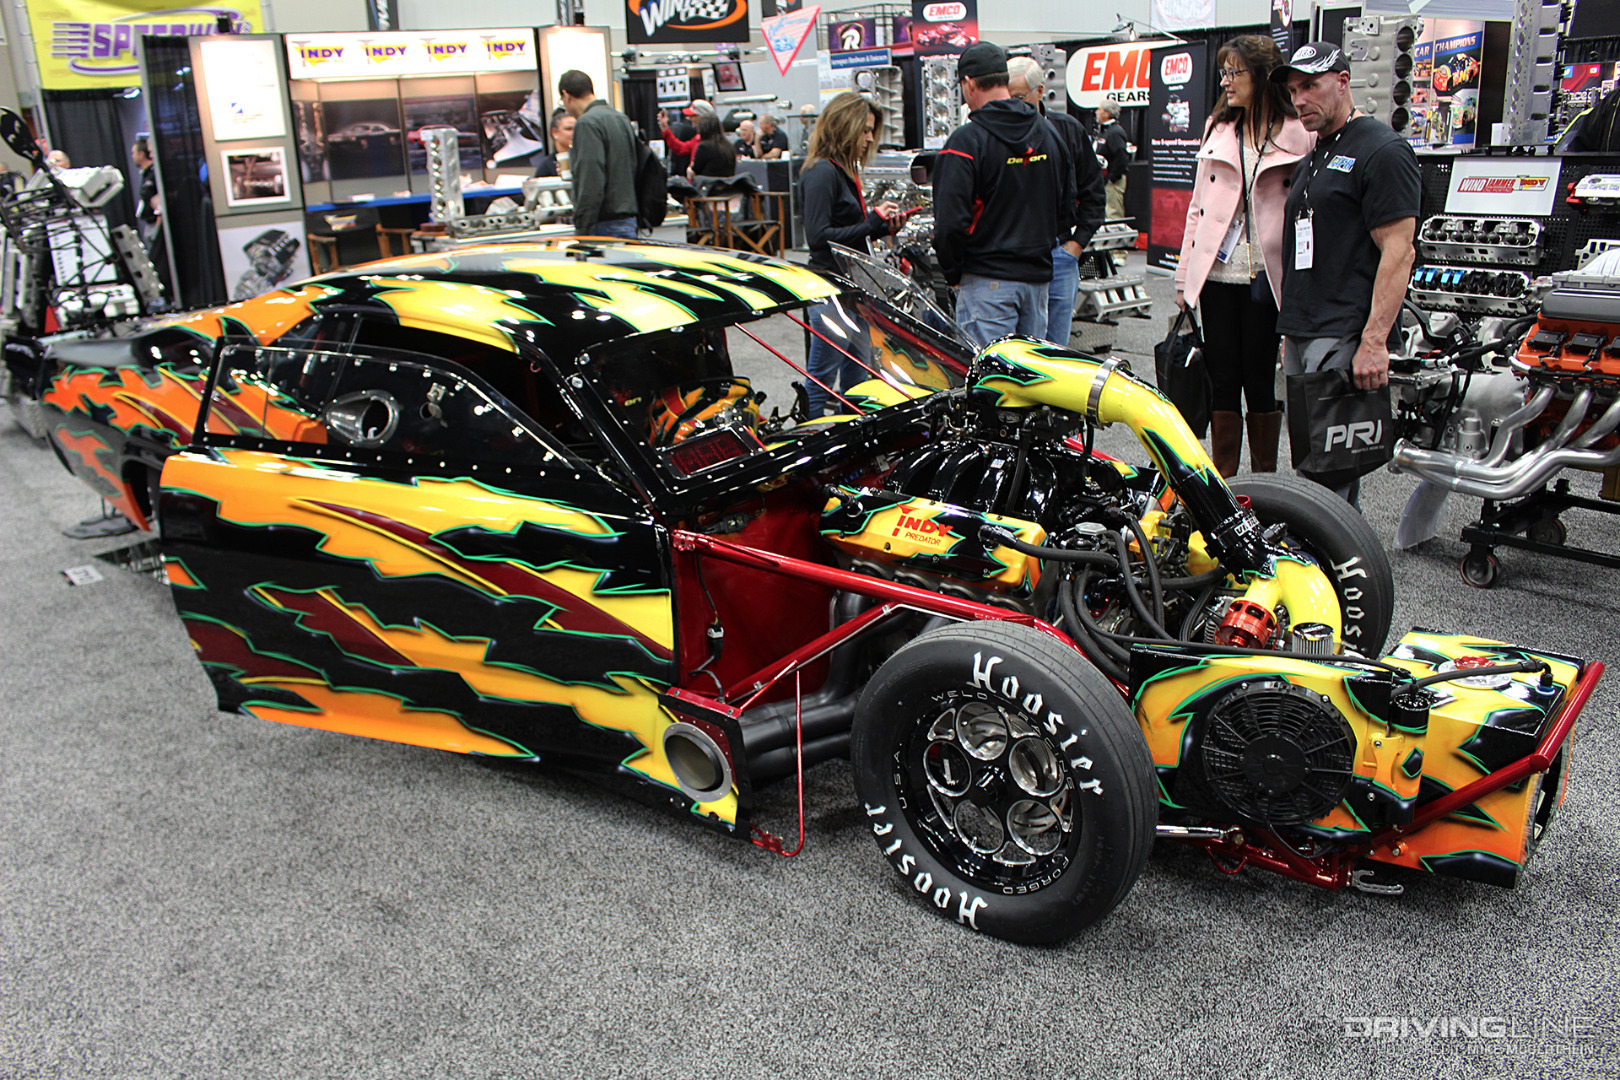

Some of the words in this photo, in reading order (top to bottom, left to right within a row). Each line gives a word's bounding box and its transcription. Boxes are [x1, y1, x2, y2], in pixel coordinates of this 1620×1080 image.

[928, 5, 960, 17] EMCO
[426, 43, 468, 55] INDY
[486, 41, 527, 53] INDY
[1435, 35, 1477, 53] CHAMPIONS
[300, 47, 344, 59] INDY
[365, 46, 407, 57] INDY
[1414, 46, 1430, 58] CAR
[1081, 48, 1151, 92] EMC
[1165, 56, 1189, 76] EMCO
[1106, 91, 1150, 102] GEAR
[1460, 178, 1487, 191] WIND
[1324, 419, 1383, 452] PRI
[892, 504, 954, 538] INDY
[904, 532, 941, 546] PREDATOR
[1330, 556, 1368, 651] Hoosi
[931, 690, 988, 701] WELD
[966, 651, 1105, 796] Hoosier
[864, 802, 989, 931] Hoosier
[1002, 856, 1070, 894] FORGED
